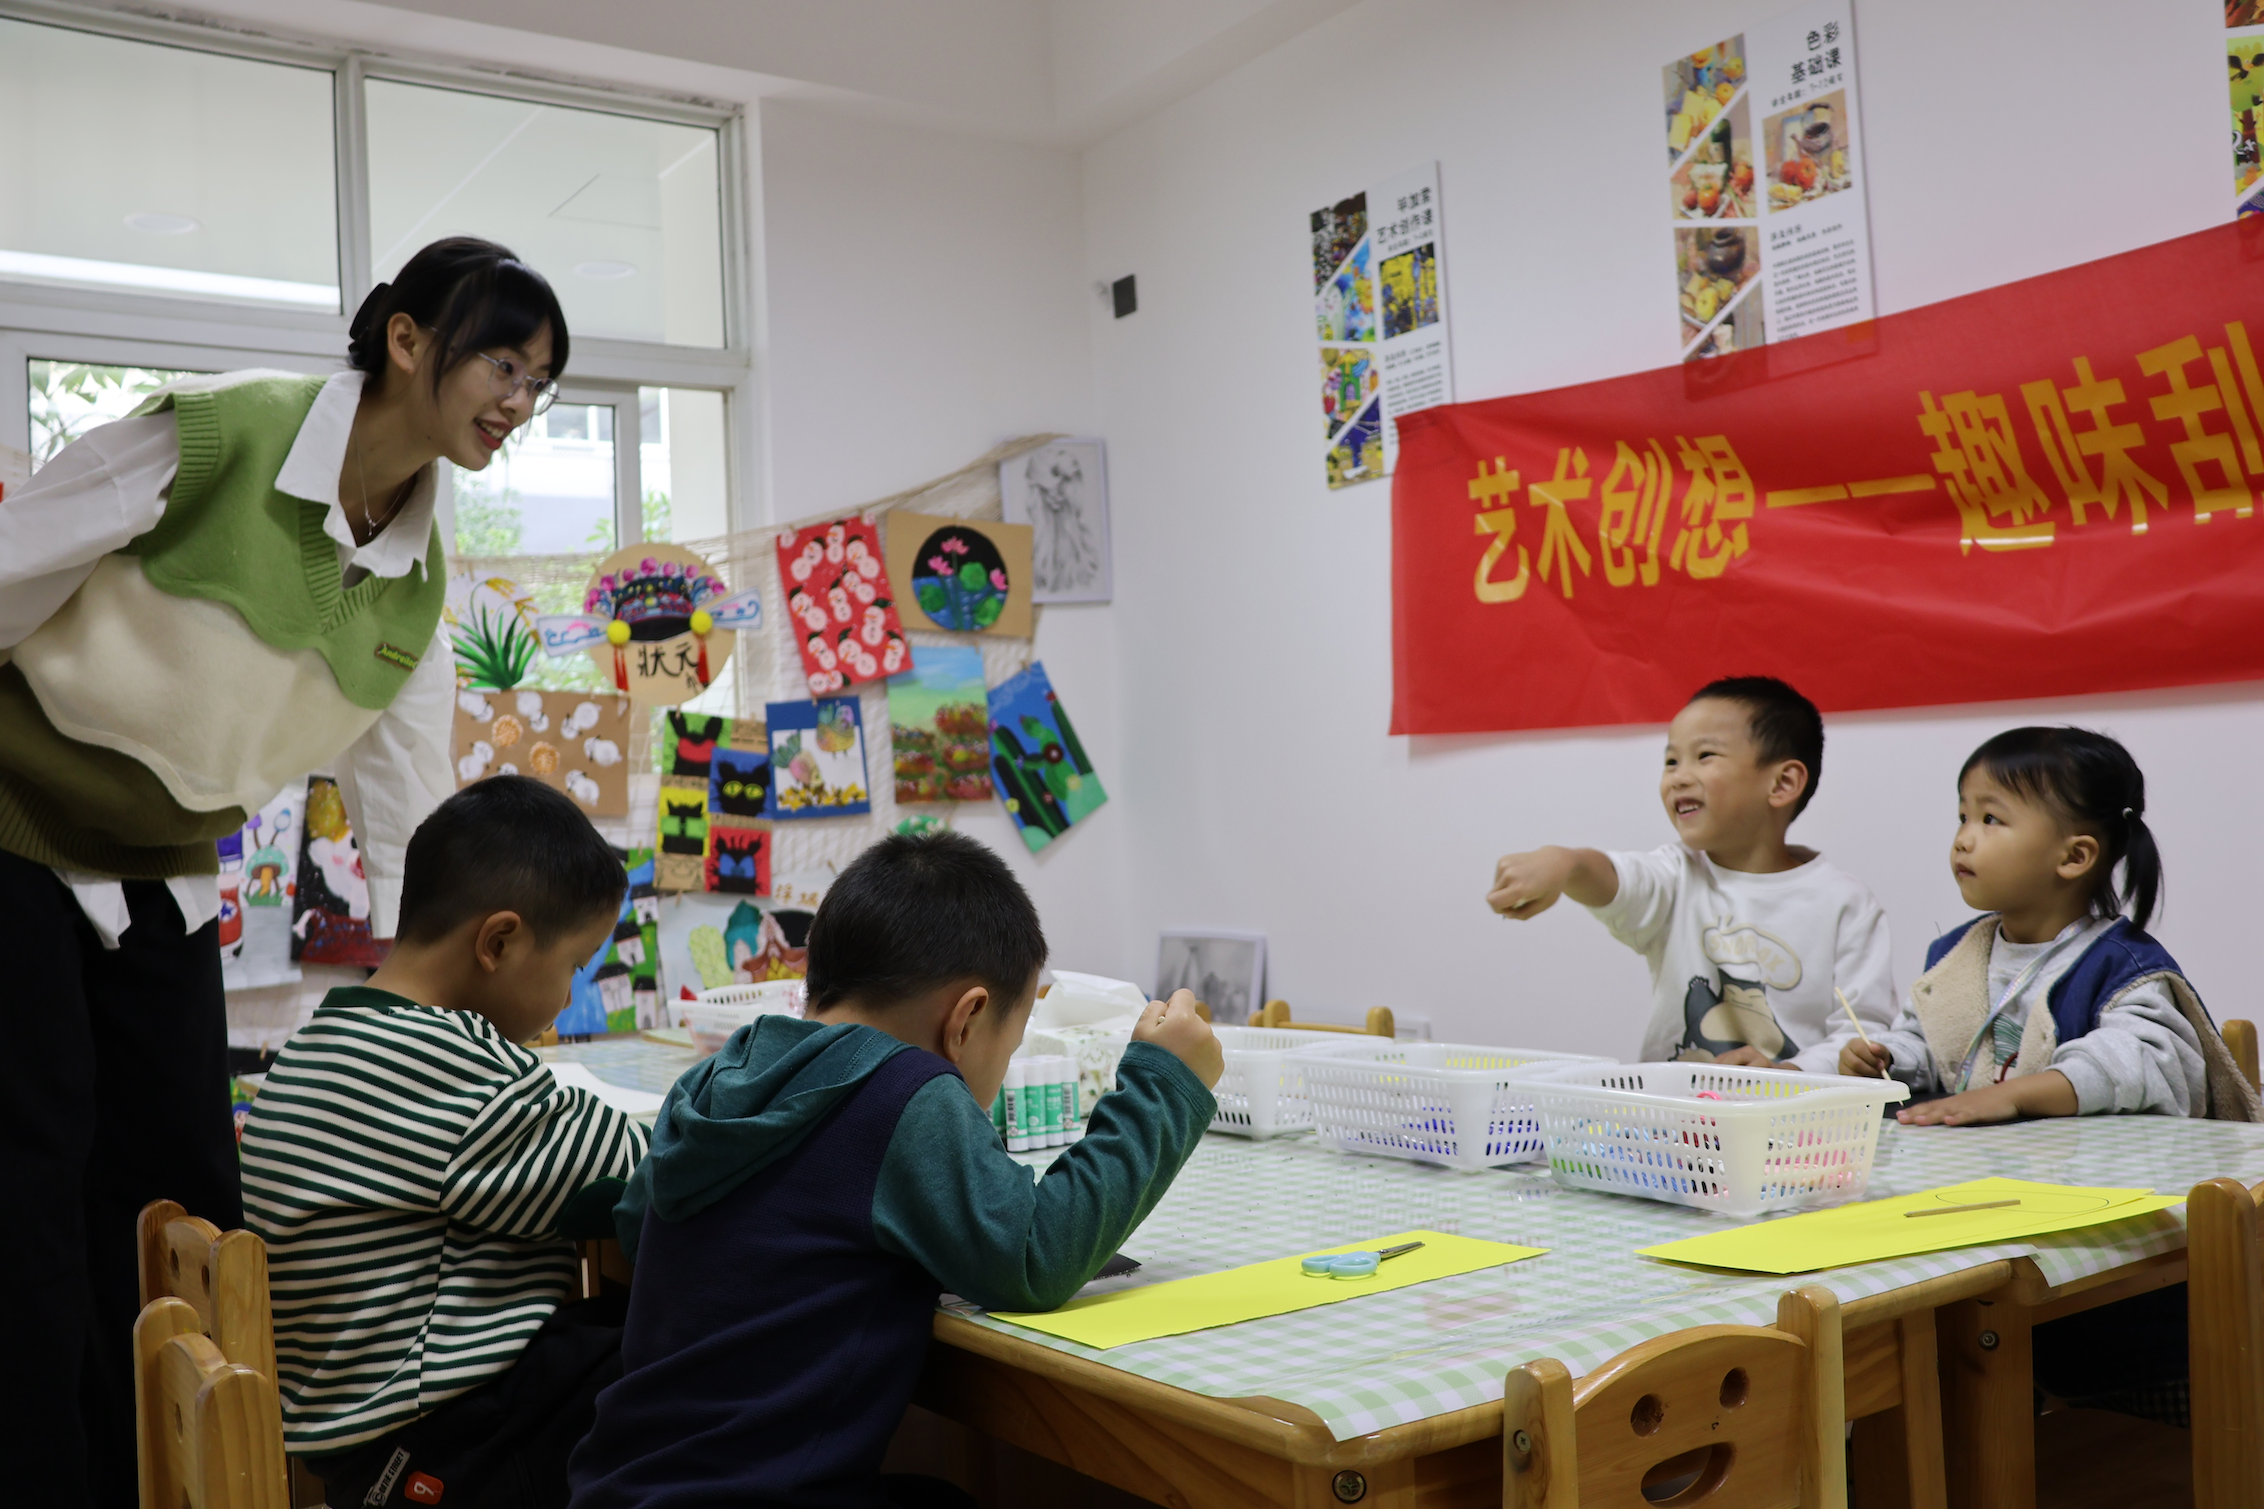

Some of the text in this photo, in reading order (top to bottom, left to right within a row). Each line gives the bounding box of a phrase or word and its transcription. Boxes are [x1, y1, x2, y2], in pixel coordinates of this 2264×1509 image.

[1806, 20, 1841, 51] 色彩
[1790, 46, 1842, 85] 基础课
